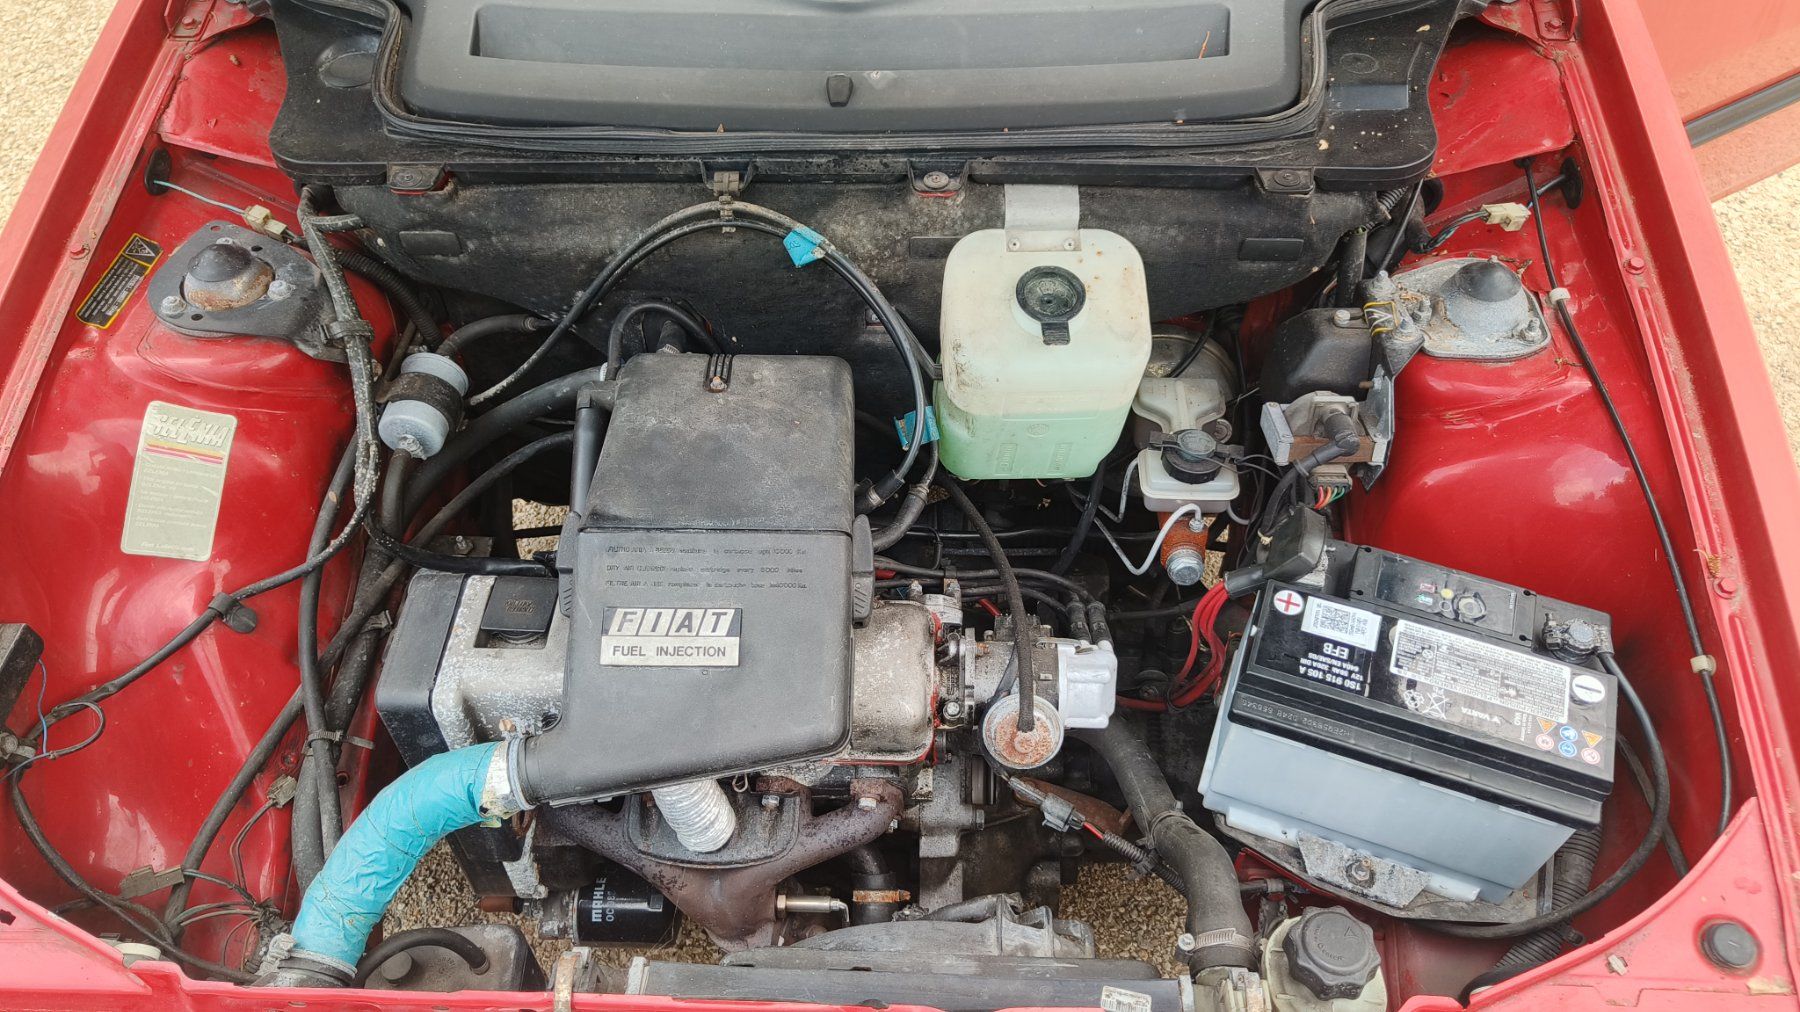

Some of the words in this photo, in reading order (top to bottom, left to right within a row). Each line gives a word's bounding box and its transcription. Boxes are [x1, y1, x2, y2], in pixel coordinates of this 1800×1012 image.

[616, 612, 728, 633] FIAT
[612, 646, 646, 656] FUEL
[656, 646, 726, 657] INJECTION
[1323, 642, 1350, 660] EFB
[1298, 665, 1306, 674] A
[1307, 668, 1324, 679] 105
[1326, 673, 1344, 686] 915
[1351, 672, 1364, 681] 12V
[1460, 706, 1490, 720] VARTA
[592, 878, 606, 922] MAHLE
[606, 908, 614, 922] OC
